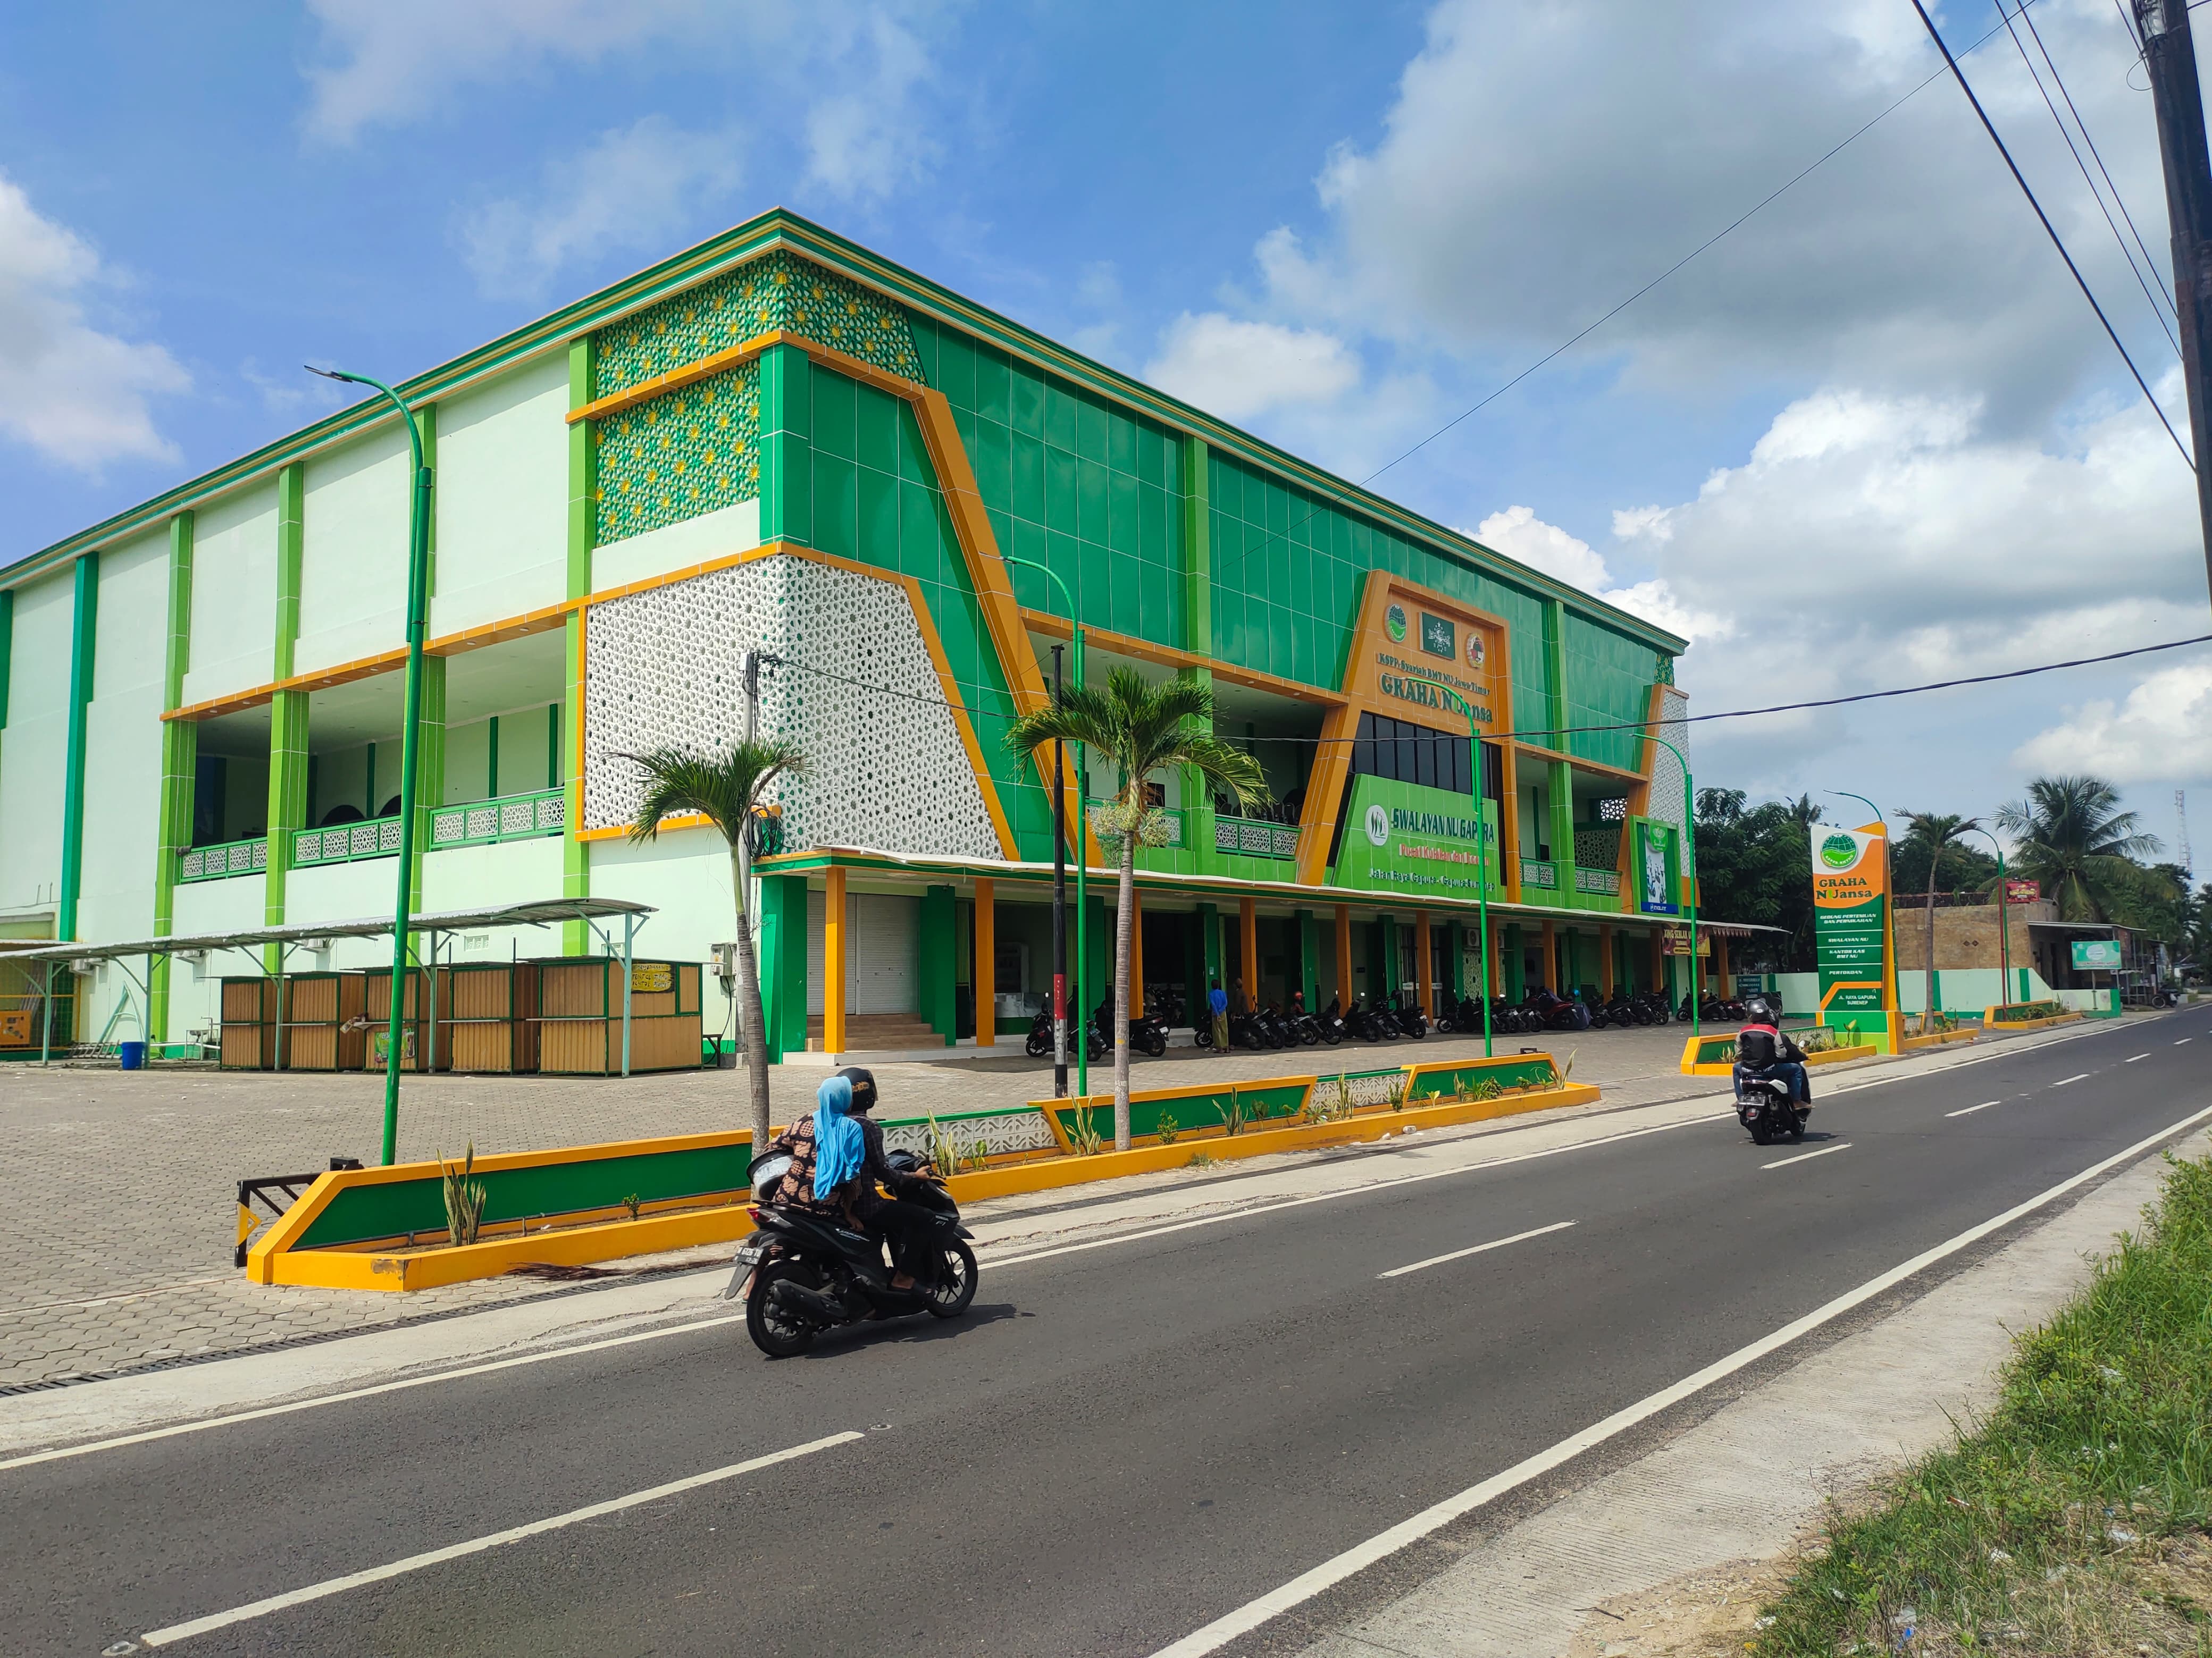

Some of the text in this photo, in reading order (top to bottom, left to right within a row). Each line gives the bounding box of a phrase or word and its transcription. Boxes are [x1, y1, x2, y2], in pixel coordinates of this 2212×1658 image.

[1381, 672, 1439, 709] GRAHA
[1427, 668, 1442, 681] BMT
[1442, 673, 1453, 684] NU
[1454, 677, 1470, 690] Jawa
[1470, 682, 1490, 695] Timur
[1392, 808, 1445, 836] SWALAYAN
[1445, 817, 1459, 837] NU
[1460, 819, 1495, 843] GAPRA
[1400, 844, 1490, 866] Pusat Kulakan dan Ecen
[1370, 868, 1391, 881] Jalan
[1391, 870, 1410, 883] Raya
[1411, 873, 1436, 886] Gapura
[1466, 879, 1495, 893] Sumnep
[1816, 877, 1873, 899] GRAHA NUansa
